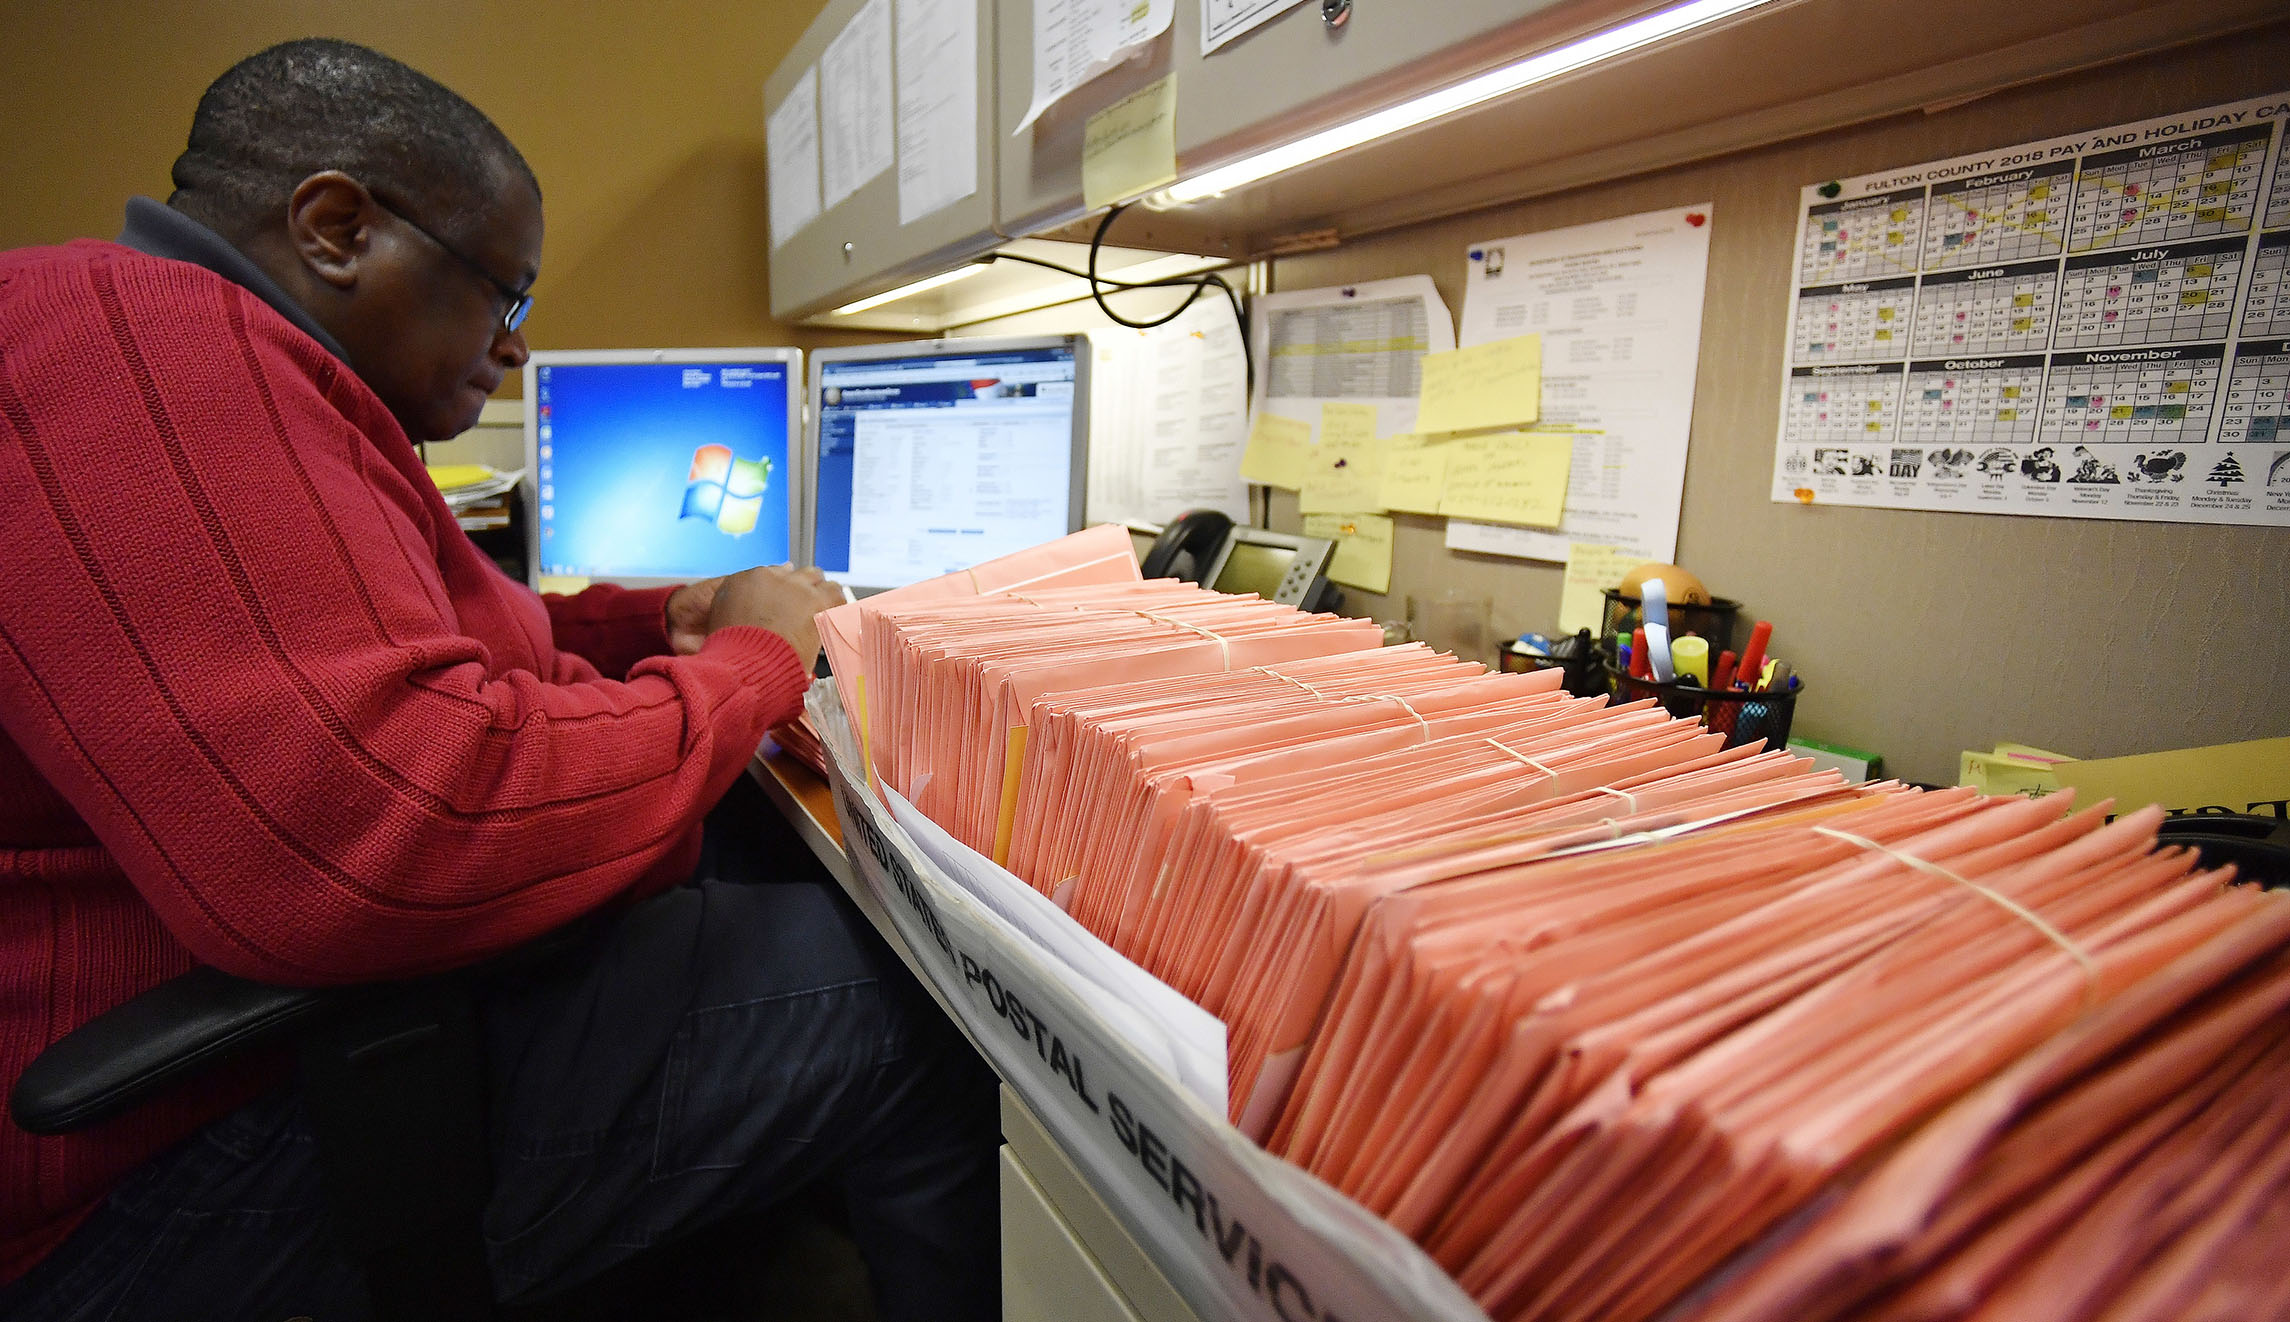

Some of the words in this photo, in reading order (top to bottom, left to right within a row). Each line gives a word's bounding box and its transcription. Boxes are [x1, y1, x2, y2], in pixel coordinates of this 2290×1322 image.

[1866, 174, 1922, 191] FULTON
[1927, 160, 1995, 180] COUNTY
[2000, 151, 2043, 166] 2018
[2050, 142, 2086, 158] PAY
[2092, 132, 2136, 149] AND
[2144, 111, 2248, 140] HOLIDAY
[2139, 139, 2202, 158] March
[2084, 169, 2100, 178] Sun
[2107, 164, 2124, 173] Mon
[2157, 155, 2176, 164] Wed
[2186, 152, 2203, 160] Thu
[2216, 146, 2230, 154] Fri
[1966, 170, 2035, 189] February
[2150, 191, 2162, 199] 14
[2173, 200, 2189, 208] 22
[2230, 192, 2248, 200] 24
[2270, 200, 2289, 208] 29
[2120, 220, 2135, 228] 27
[2145, 217, 2160, 225] 28
[2131, 249, 2169, 261] July
[2263, 248, 2282, 256] Sun
[2138, 261, 2156, 269] Wed
[1968, 269, 2005, 280] June
[1841, 284, 1870, 293] May
[2208, 300, 2225, 308] 28
[2086, 349, 2181, 363] November
[1944, 359, 2005, 370] October
[2200, 358, 2216, 367] Sat
[1889, 464, 1921, 477] DAY
[958, 949, 1099, 1115] POSTAL
[1108, 1091, 1340, 1322] SERVIC
